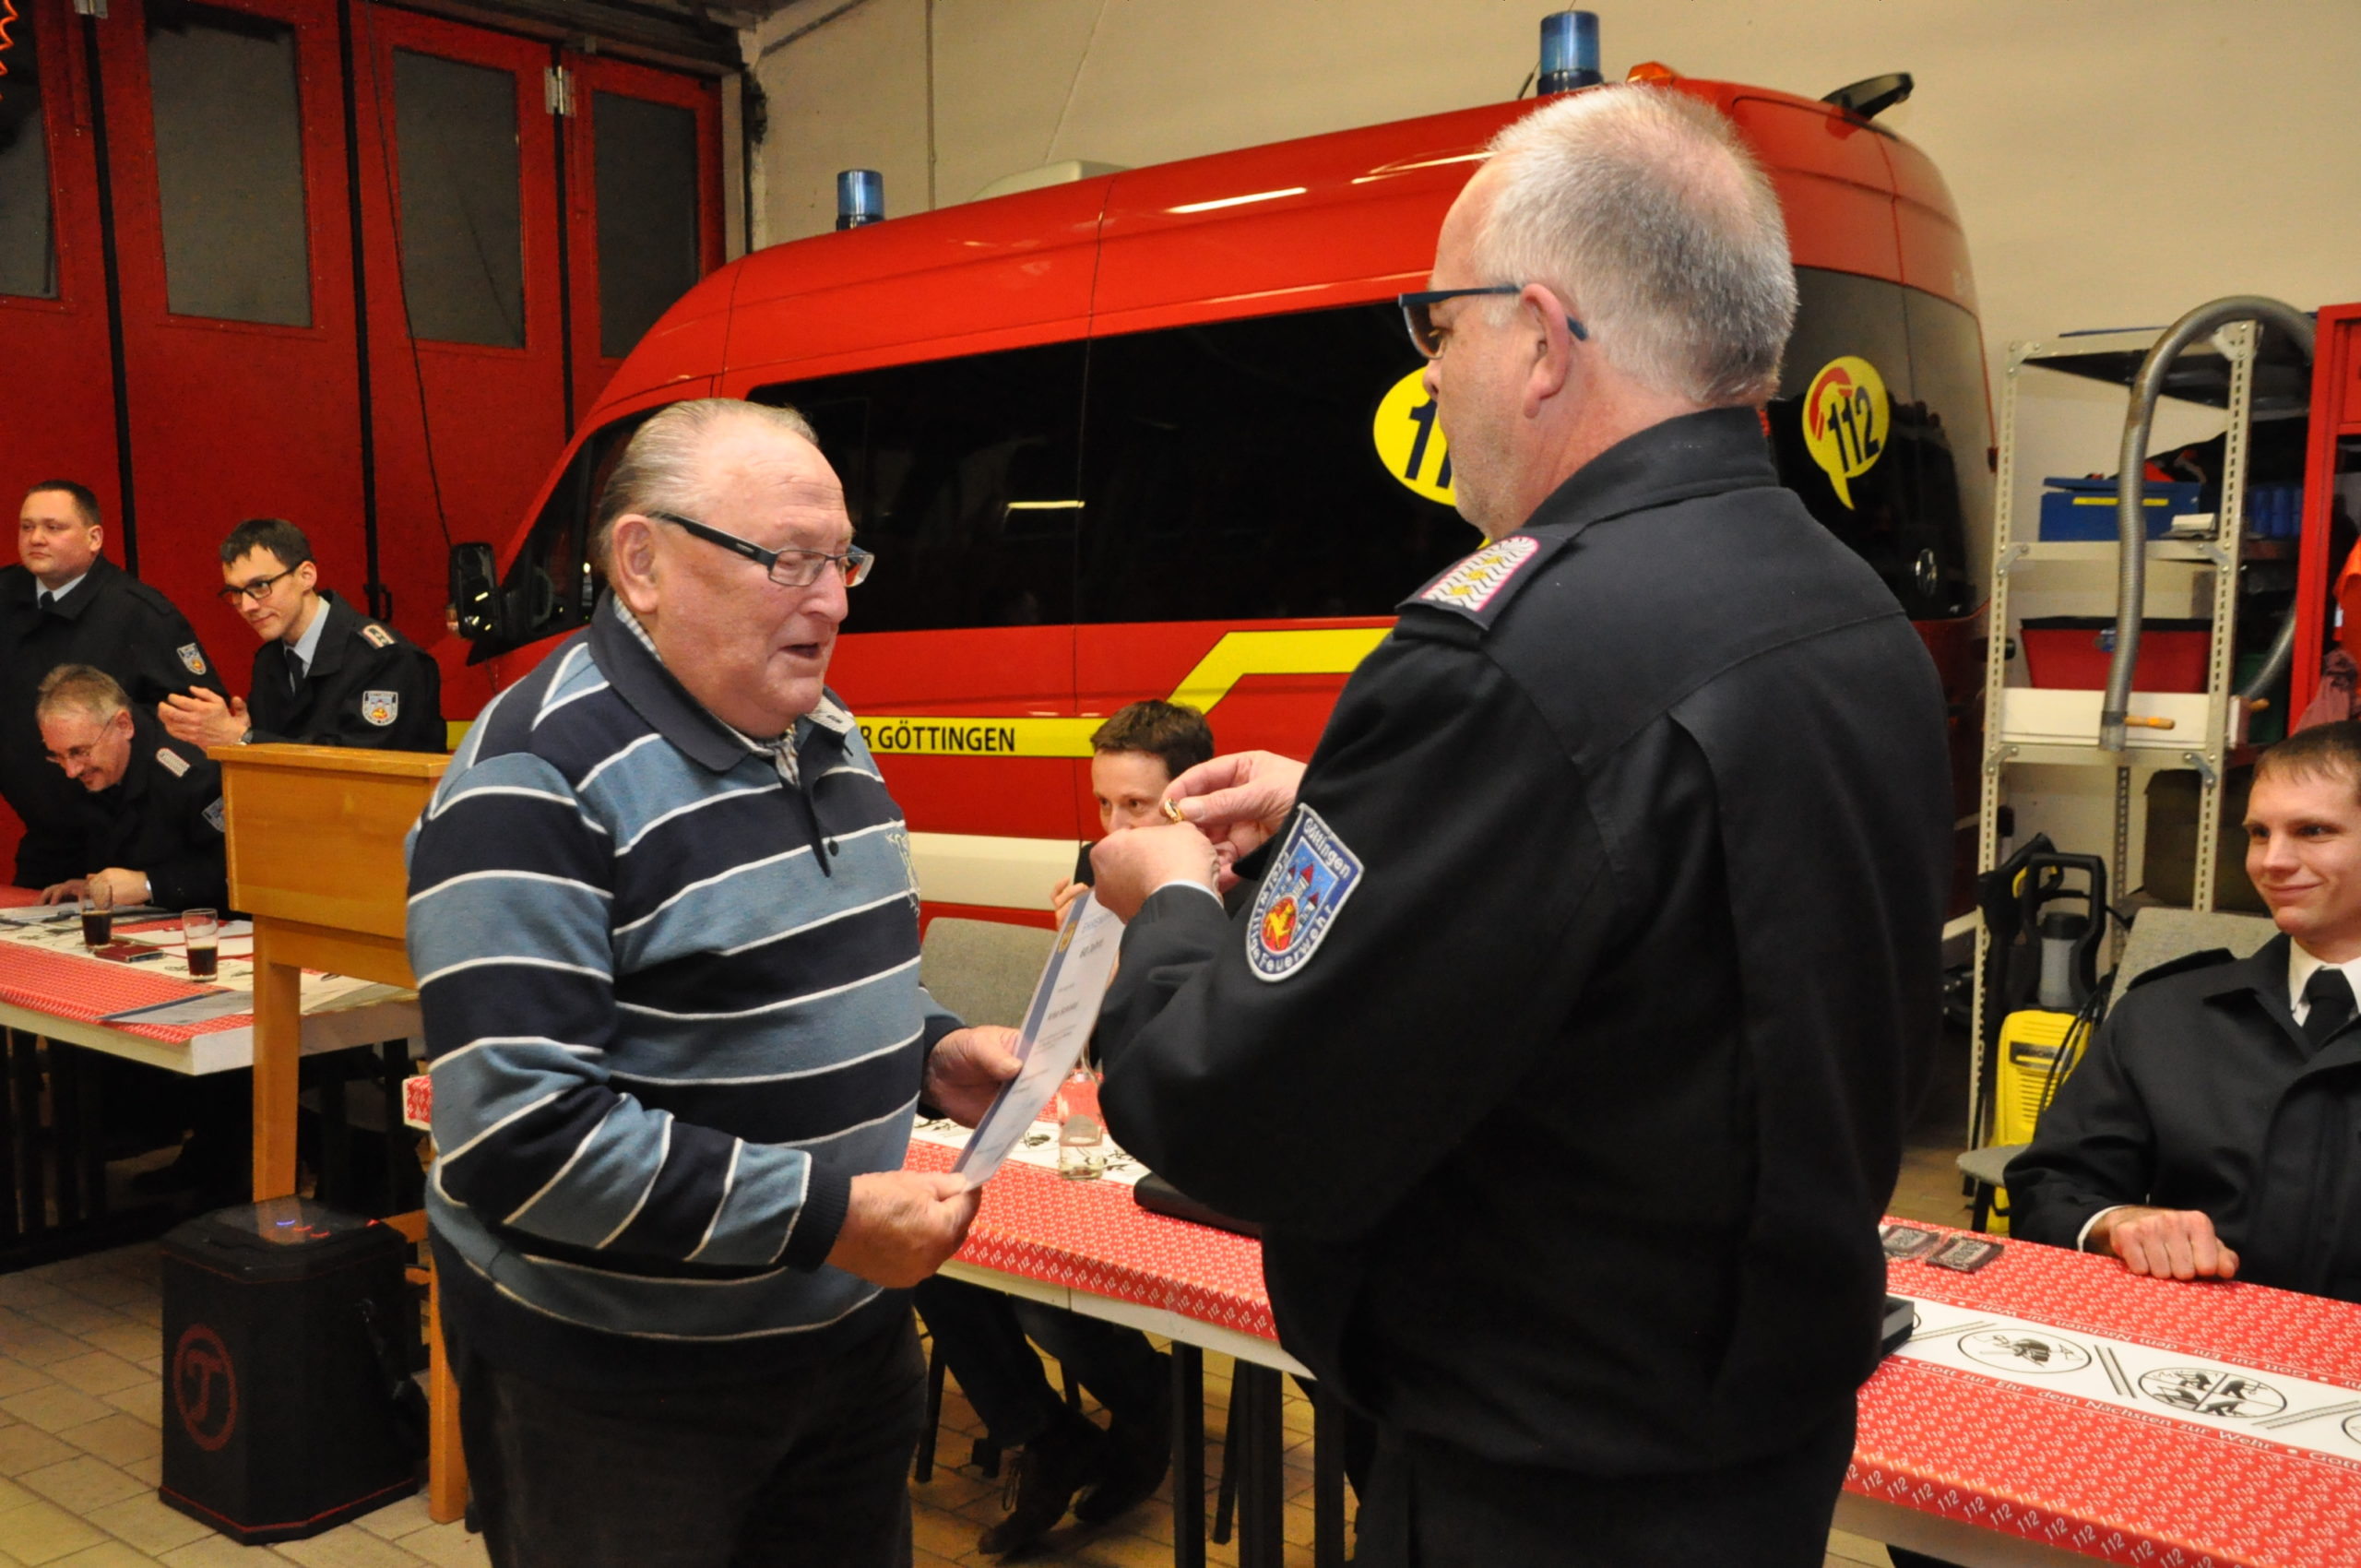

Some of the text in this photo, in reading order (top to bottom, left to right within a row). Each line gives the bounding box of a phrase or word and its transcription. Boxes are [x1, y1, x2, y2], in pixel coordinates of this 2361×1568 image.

[1828, 386, 1880, 474] 112
[878, 719, 1015, 752] GÖTTINGEN
[1303, 817, 1351, 879] Göttingen
[1258, 904, 1334, 971] Feuerwehr
[1918, 1362, 1957, 1376] Gott
[1962, 1373, 1989, 1384] zur
[2037, 1391, 2078, 1404] dem
[2178, 1424, 2211, 1435] zur
[2219, 1431, 2275, 1449] Wehr
[2309, 1452, 2361, 1470] Gott
[1862, 1470, 1883, 1491] 112
[1887, 1477, 1908, 1498] 112
[1912, 1483, 1934, 1504] 112
[1938, 1490, 1960, 1512] 112
[1964, 1496, 1985, 1518] 112
[1989, 1503, 2012, 1526] 112
[2017, 1510, 2039, 1533] 112
[2045, 1517, 2068, 1540] 112
[2072, 1525, 2095, 1548] 112
[2101, 1532, 2125, 1555] 112
[2130, 1540, 2154, 1563] 112
